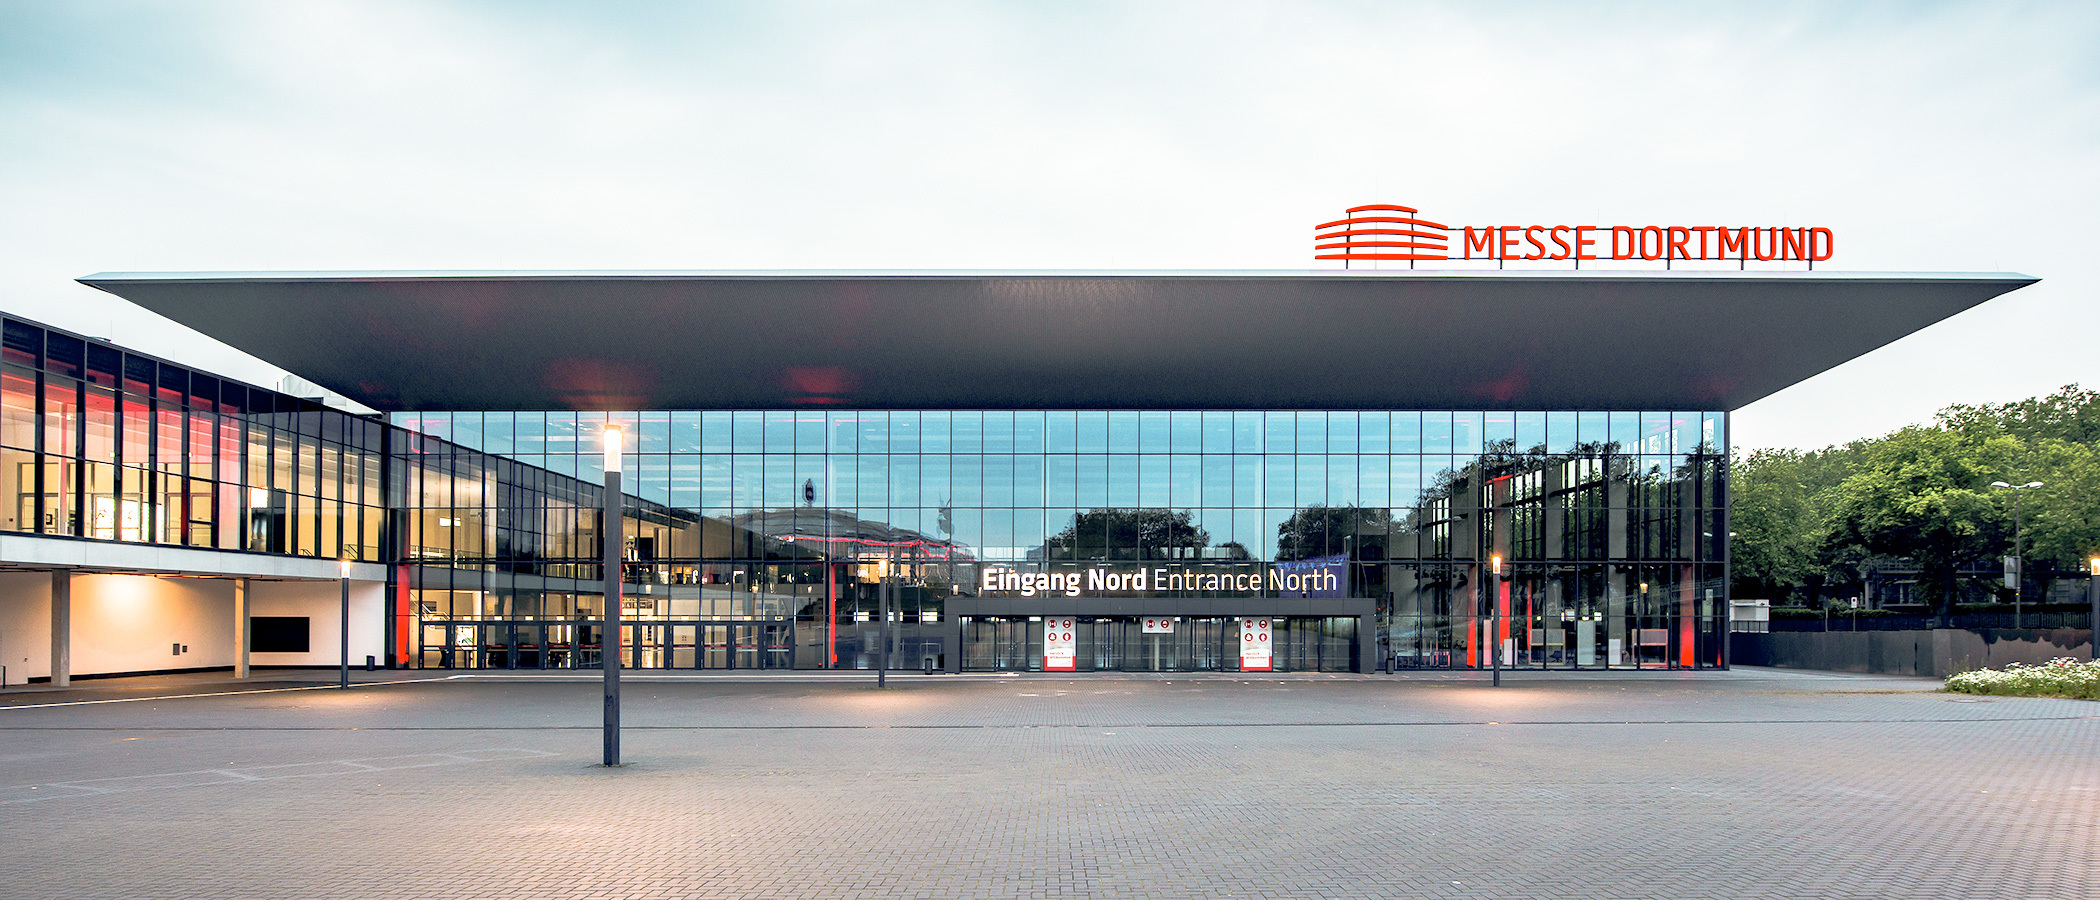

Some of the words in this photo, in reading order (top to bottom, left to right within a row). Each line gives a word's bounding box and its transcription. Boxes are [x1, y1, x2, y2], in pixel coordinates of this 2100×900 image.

[1464, 225, 1597, 260] MESSE
[1612, 225, 1834, 261] DORTMUND
[983, 568, 1081, 597] Eingang
[1088, 568, 1147, 591] Nord
[1154, 568, 1262, 591] Entrance
[1269, 568, 1337, 591] North
